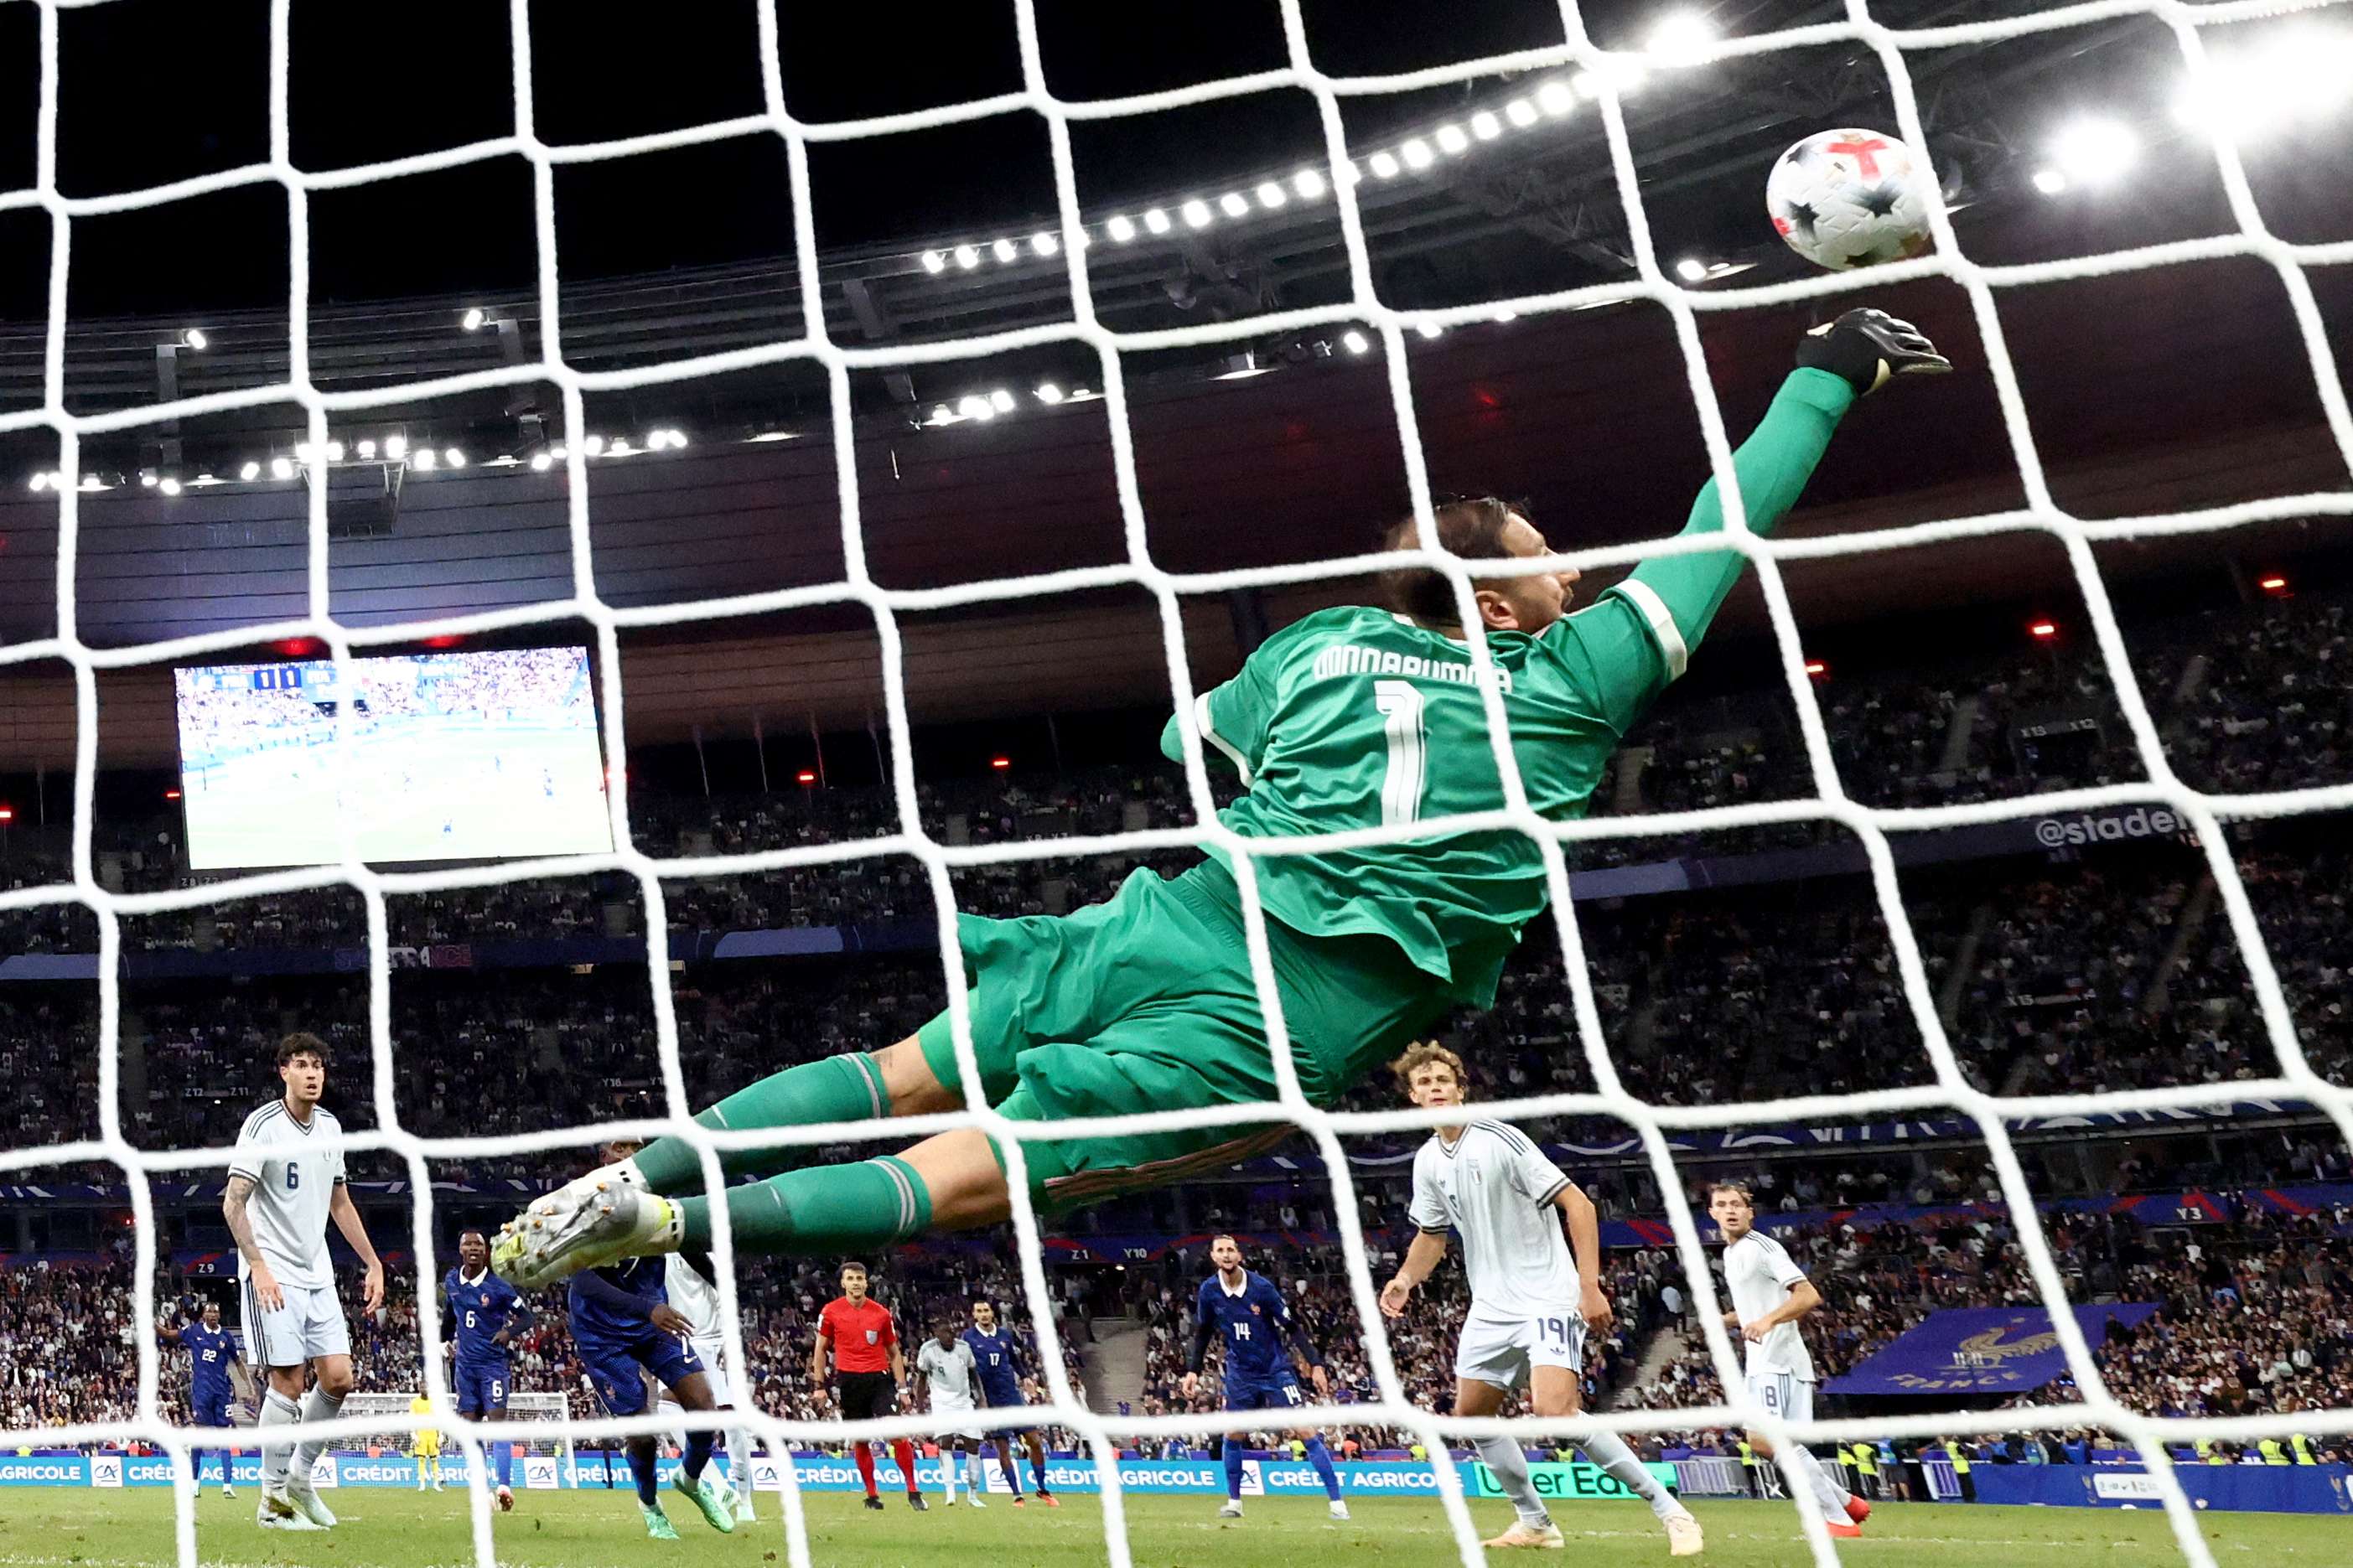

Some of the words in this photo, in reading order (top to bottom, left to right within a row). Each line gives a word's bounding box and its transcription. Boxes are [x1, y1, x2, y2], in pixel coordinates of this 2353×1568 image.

[287, 1162, 299, 1189] 6
[198, 1263, 215, 1274] Z9
[465, 1310, 476, 1328] 6
[1233, 1322, 1252, 1341] 14
[1537, 1317, 1565, 1344] 19
[201, 1348, 217, 1363] 22
[989, 1353, 1000, 1367] 17
[491, 1379, 503, 1398] 6
[1283, 1384, 1302, 1405] 14
[0, 1466, 81, 1481] GRICOLE
[343, 1464, 412, 1482] CRÉDIT
[1268, 1468, 1345, 1488] CRÉDT
[1353, 1472, 1464, 1488] AGRICOE
[1480, 1465, 1564, 1494] Uer
